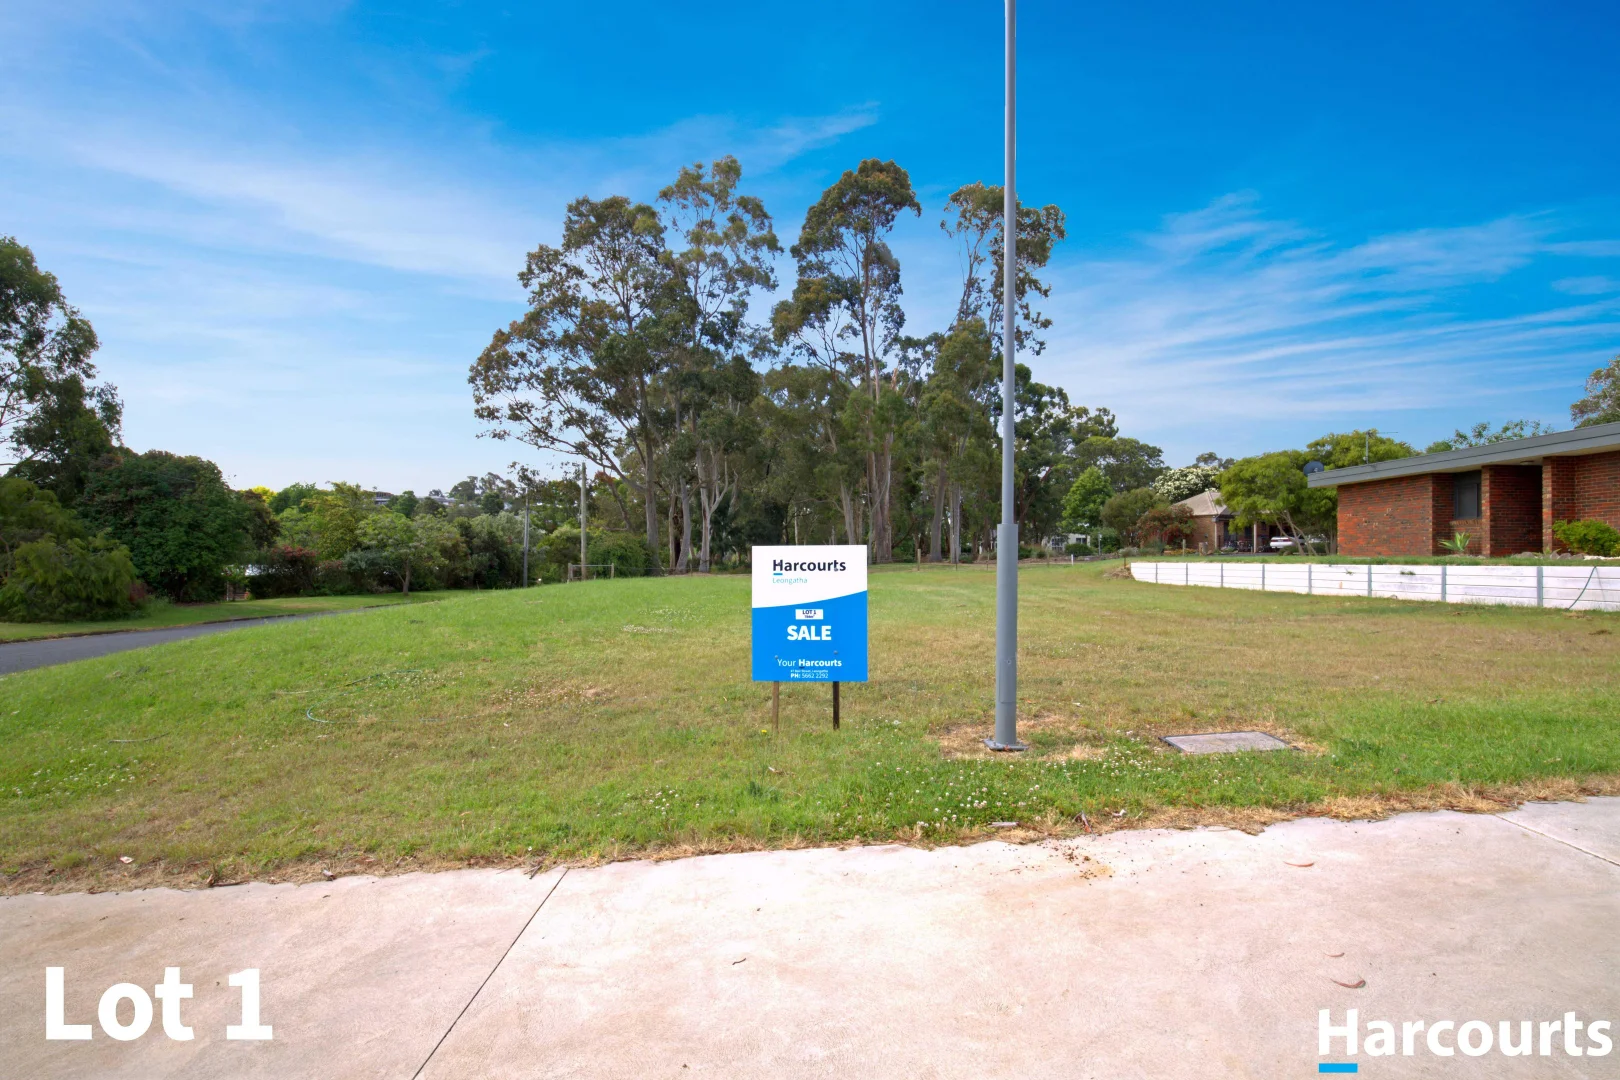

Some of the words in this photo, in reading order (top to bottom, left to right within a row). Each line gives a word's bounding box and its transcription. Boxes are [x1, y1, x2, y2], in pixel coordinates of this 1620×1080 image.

[773, 559, 846, 572] Harcourts
[772, 577, 808, 585] Leongatha
[787, 625, 832, 641] SALE
[777, 659, 796, 667] Your
[798, 658, 842, 667] Harcourts
